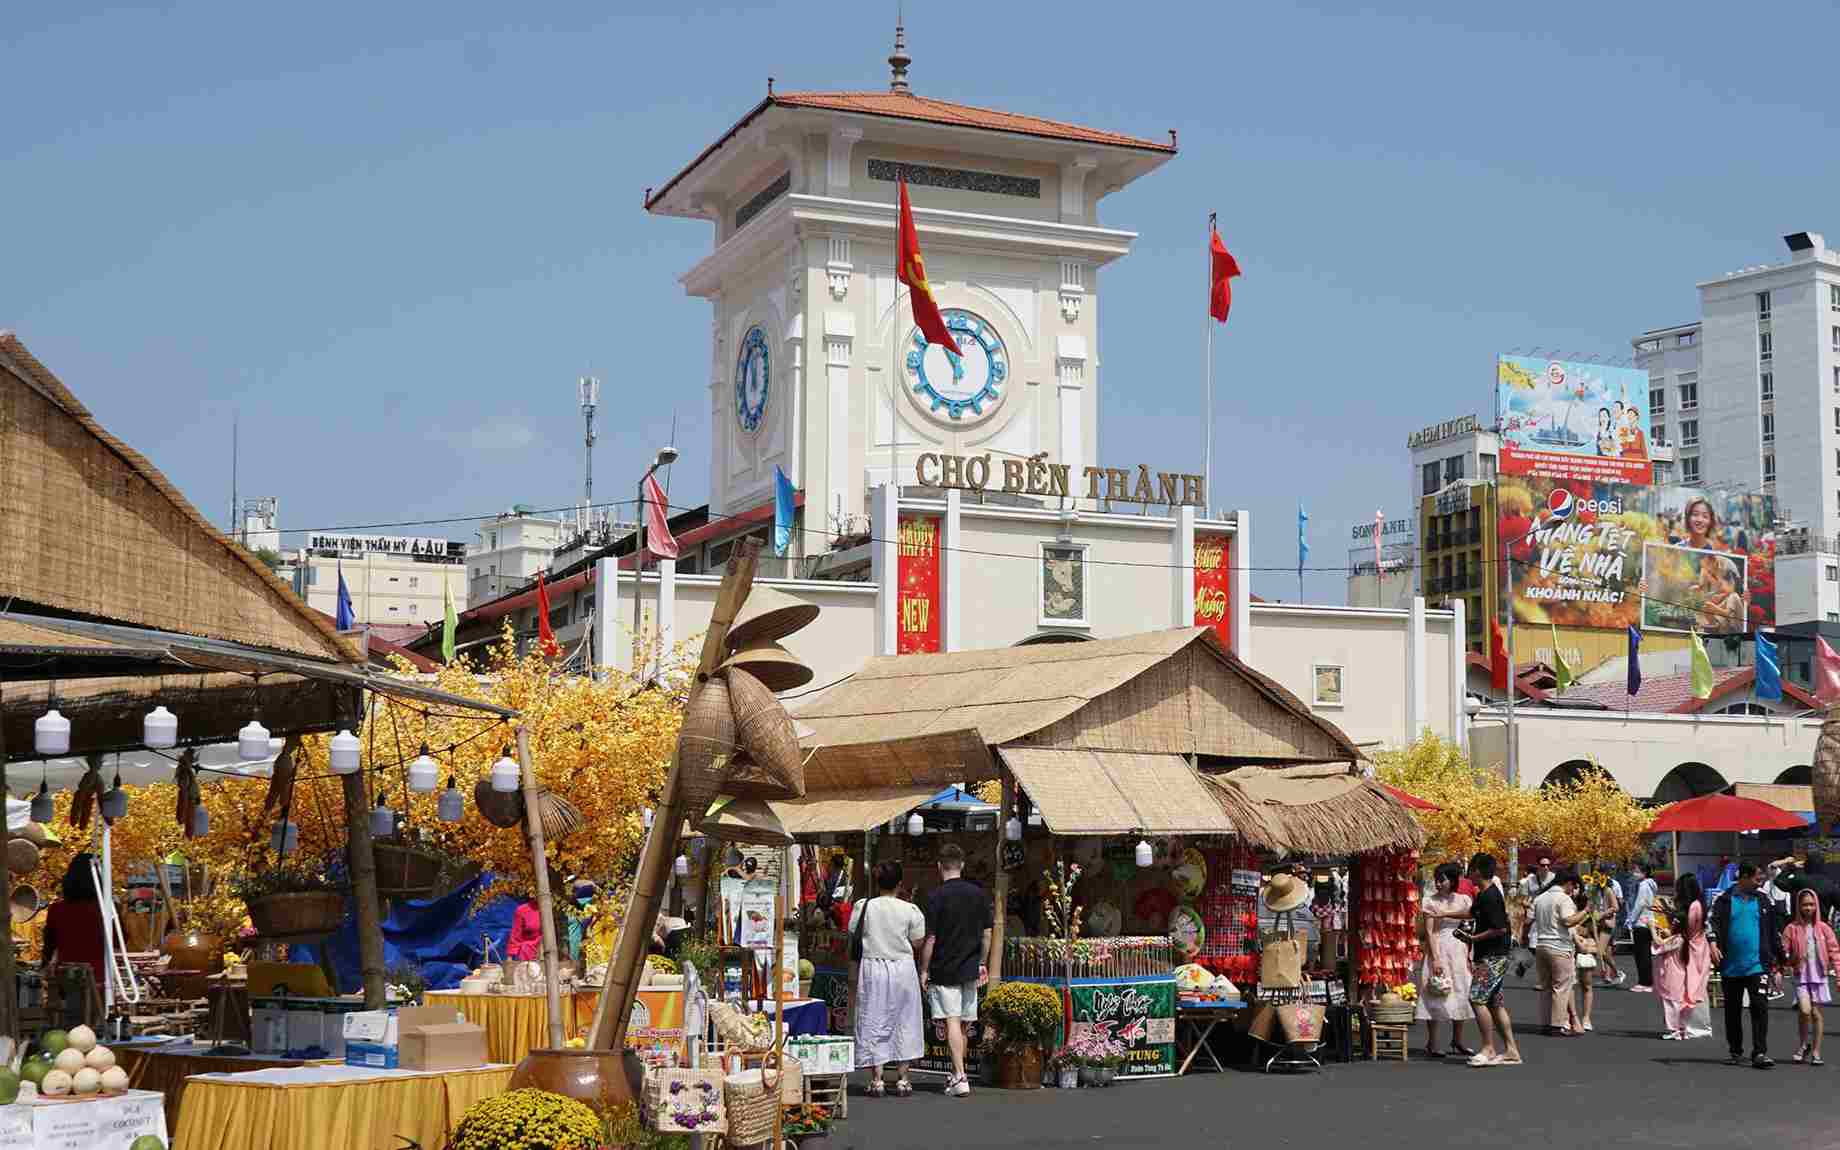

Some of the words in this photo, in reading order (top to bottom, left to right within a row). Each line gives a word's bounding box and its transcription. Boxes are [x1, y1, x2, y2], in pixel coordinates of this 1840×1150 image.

[916, 452, 991, 495] CHỢ
[1001, 452, 1071, 497] BẾN
[1083, 464, 1203, 506] THÀNH
[1576, 495, 1622, 514] pepsi
[1526, 515, 1594, 546] MANG
[1541, 544, 1577, 578] VỀ
[1579, 551, 1628, 581] NHÀ
[903, 597, 929, 633] NEW
